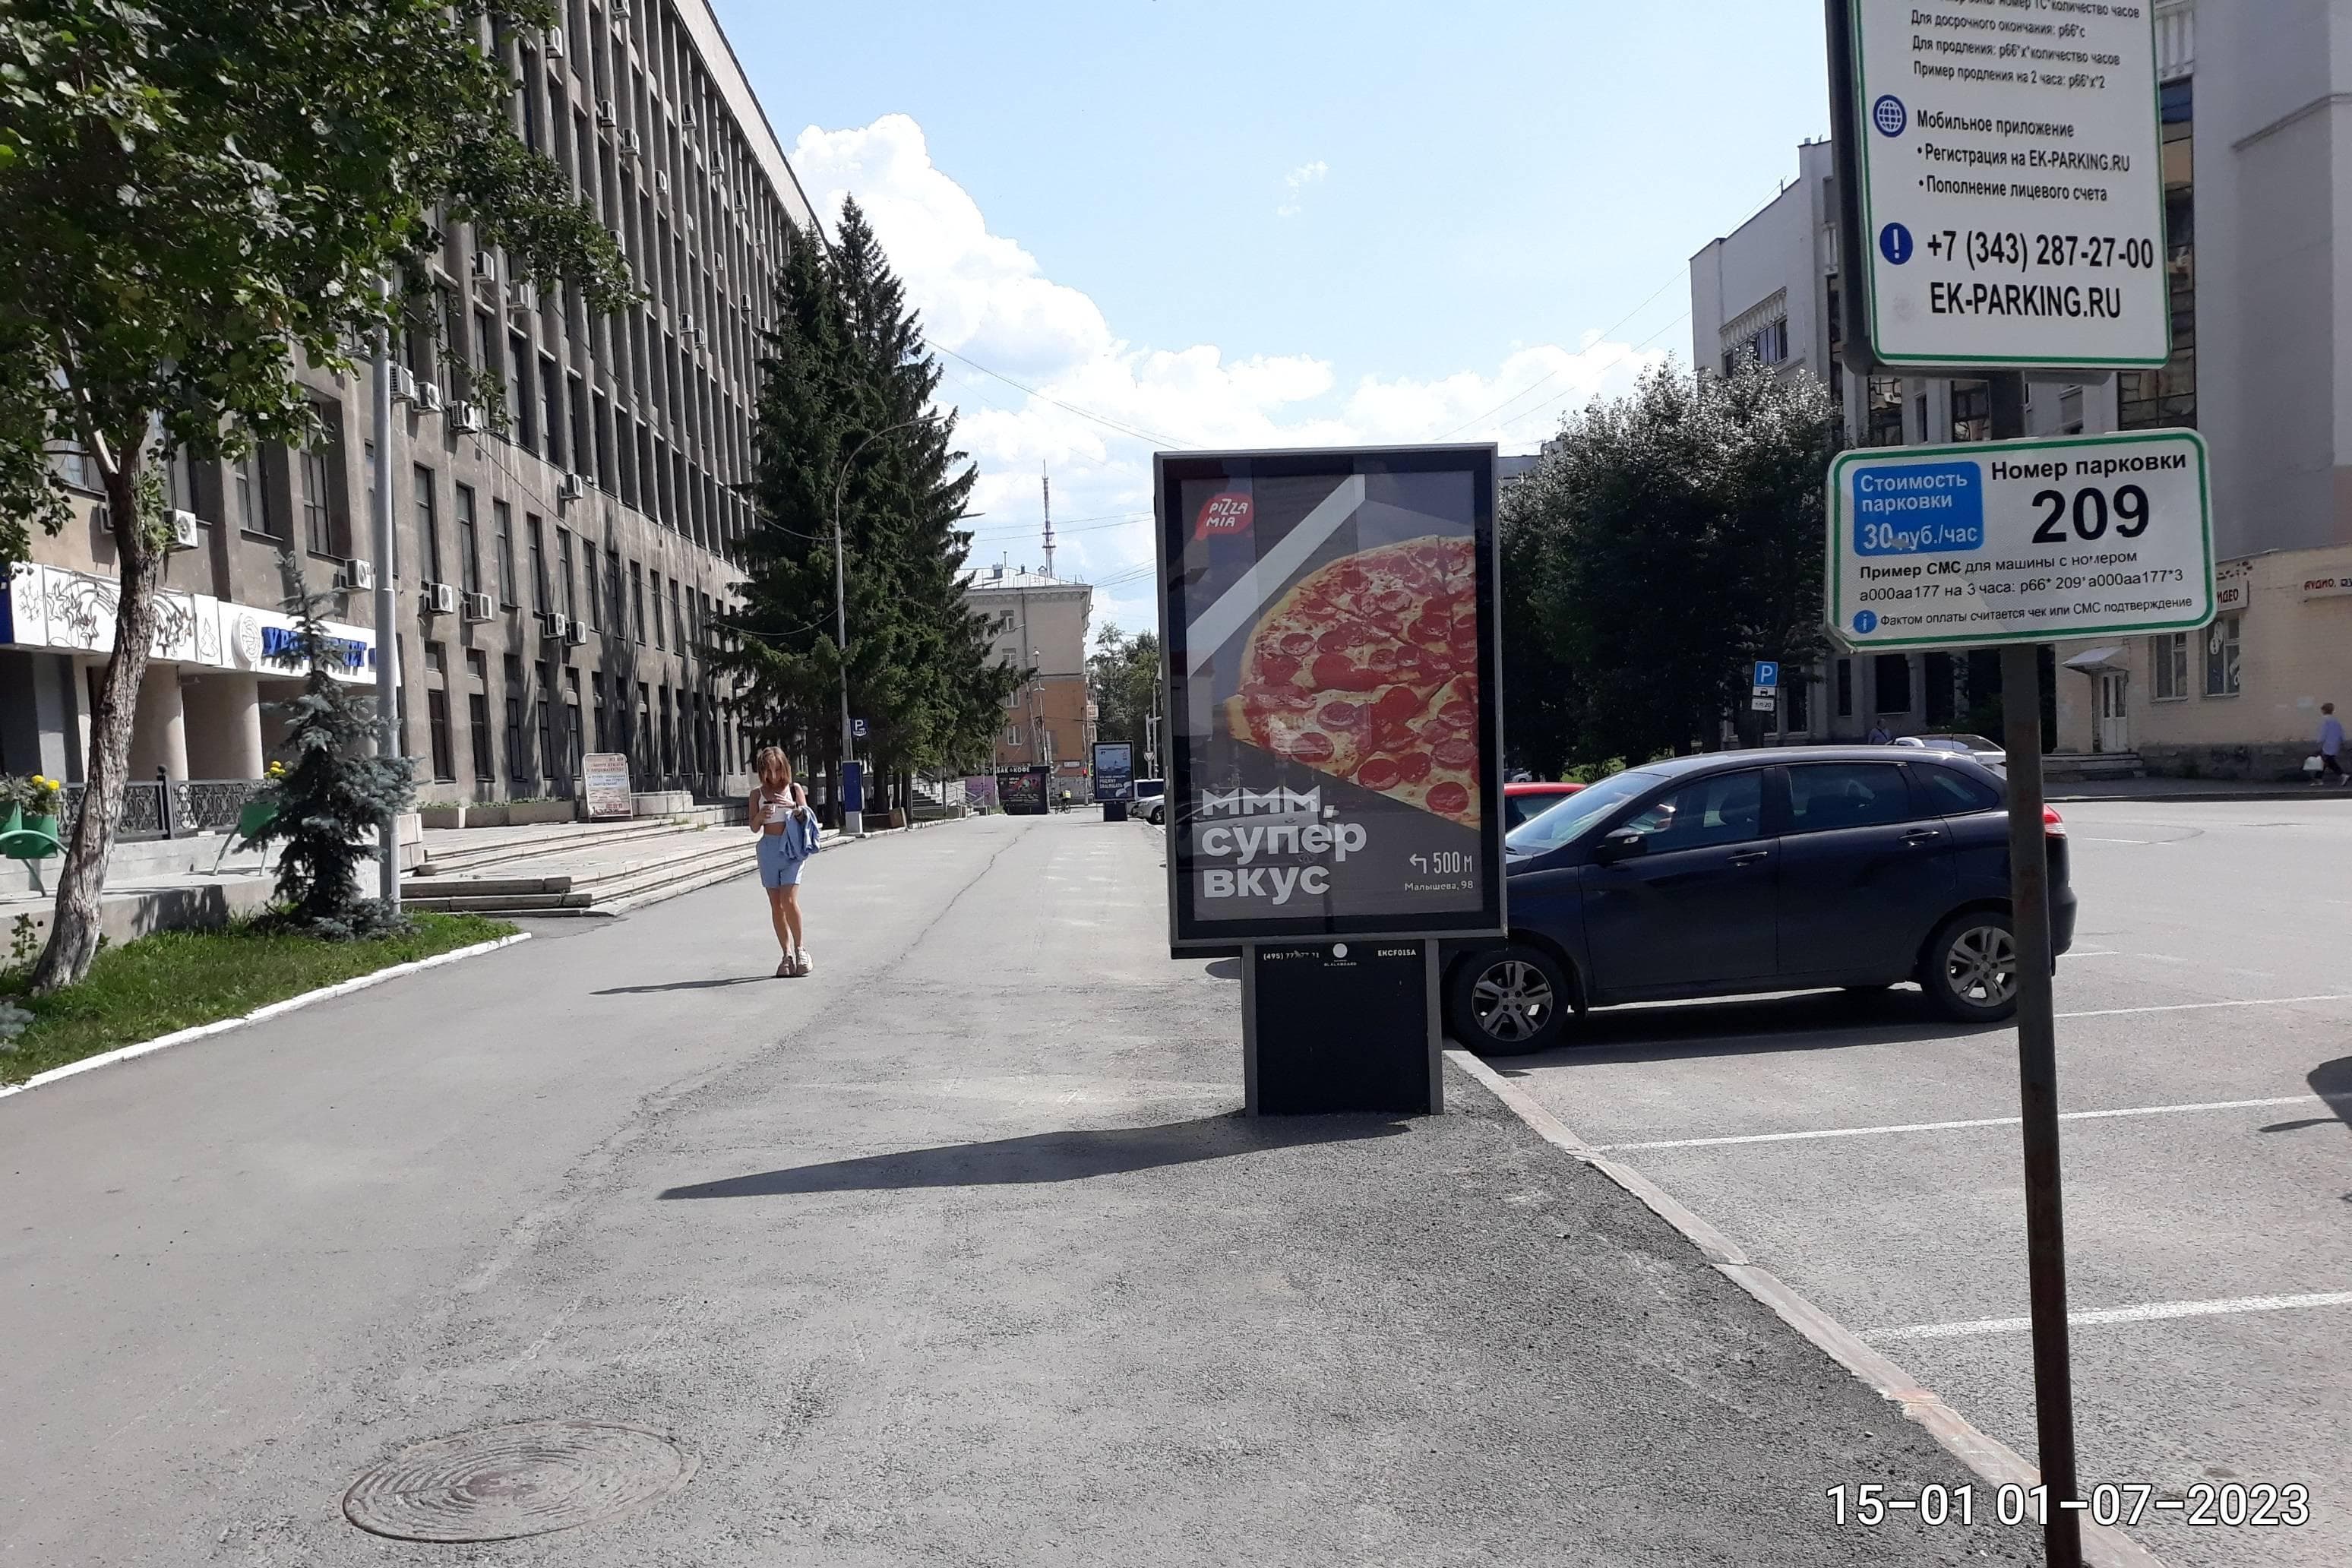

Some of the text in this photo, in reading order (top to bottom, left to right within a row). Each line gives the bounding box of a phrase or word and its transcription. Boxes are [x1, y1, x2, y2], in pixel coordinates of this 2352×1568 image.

[1911, 9, 1932, 26] Для
[1935, 14, 1996, 30] досрочного
[1999, 21, 2055, 35] окончания:
[2111, 7, 2140, 18] часов
[1913, 35, 1933, 52] Для
[1936, 40, 1996, 55] продления:
[2091, 53, 2120, 65] часов
[1914, 61, 1955, 80] Пример
[1958, 67, 2013, 81] продления
[2017, 72, 2028, 83] на
[2031, 70, 2037, 84] 2
[2041, 74, 2066, 86] часа:
[1917, 109, 2074, 138] Мобильное приложение
[1925, 143, 2130, 172] Регистрация на EK-PARKING.RU
[1927, 175, 2107, 201] Пополнение лицевого счета
[1927, 230, 2154, 273] +7 (343) 287-27-00
[1930, 282, 2121, 318] EK-PARKING.RU
[1991, 454, 2187, 482] Номер парковки
[1861, 474, 1968, 492] Стоимость
[1209, 498, 1248, 516] PIZZA
[1863, 495, 1952, 515] парковки
[2031, 484, 2150, 544] 209
[1206, 517, 1235, 527] MIA
[1864, 523, 1893, 549] 30
[1860, 566, 1921, 580] Пример
[1927, 561, 1962, 575] СМС
[1965, 561, 1991, 575] для
[1996, 557, 2055, 571] машины
[2060, 557, 2067, 567] с
[1860, 584, 1939, 602] а000аа177
[1945, 586, 1962, 596] на
[1967, 583, 1975, 596] 3
[1979, 582, 2015, 595] часа:
[2217, 588, 2239, 604] ИДЕО
[1880, 597, 2192, 626] Фактом оплаты считается чек или СМС подтверждение
[1761, 665, 1773, 683] P
[1201, 822, 1367, 865] супер
[1433, 852, 1460, 874] 500
[1204, 865, 1330, 905] вкус
[1405, 880, 1473, 892] Малышева, 98
[1263, 953, 1284, 961] (495)
